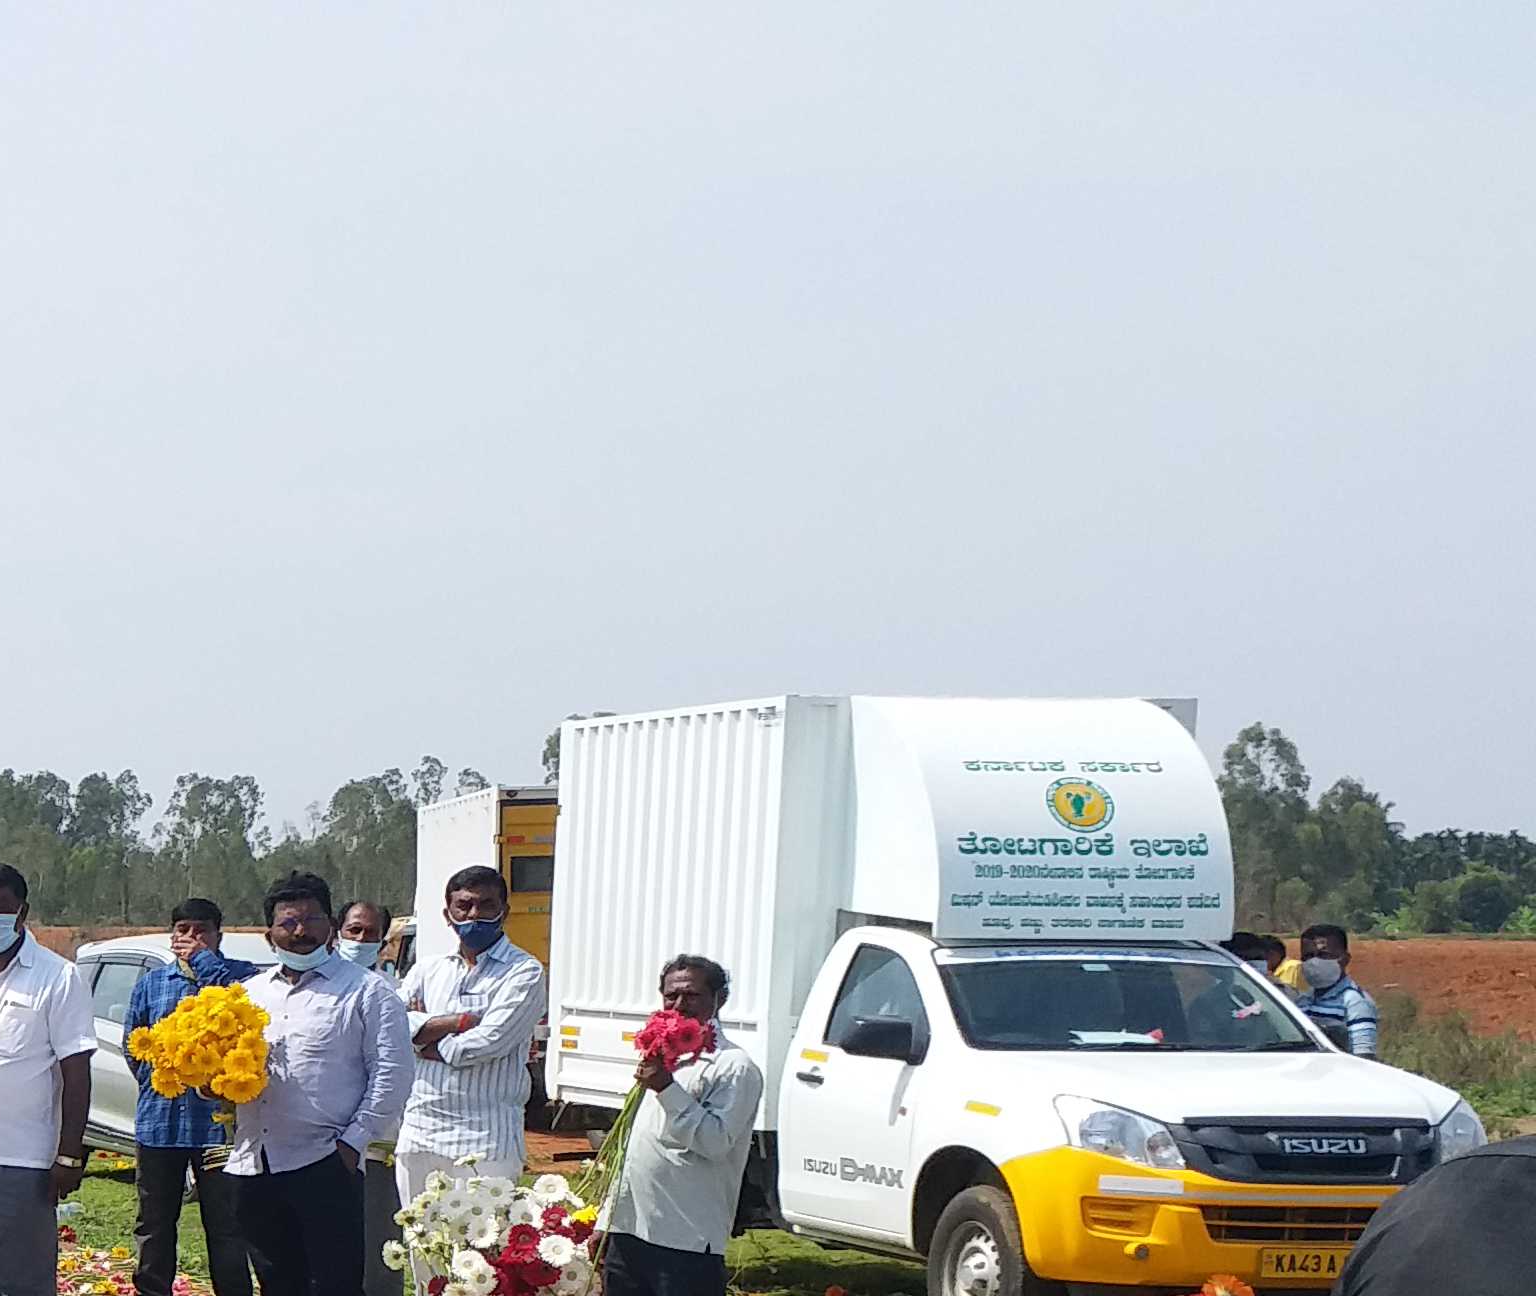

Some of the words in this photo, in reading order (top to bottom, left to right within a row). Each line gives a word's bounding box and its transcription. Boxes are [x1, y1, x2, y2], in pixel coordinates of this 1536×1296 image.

[962, 760, 1065, 772] ಕರ್ನಾಟಕ
[1078, 761, 1163, 773] ಸರ್ಕಾರ
[957, 832, 1114, 856] ತೋಟಗಾರಿಕೆ
[1130, 833, 1208, 857] ಇಲಾಖೆ
[1282, 1138, 1367, 1154] ISUZU
[803, 1158, 838, 1177] ISUZU
[840, 1156, 905, 1189] D-MAX
[1275, 1253, 1322, 1273] KA43
